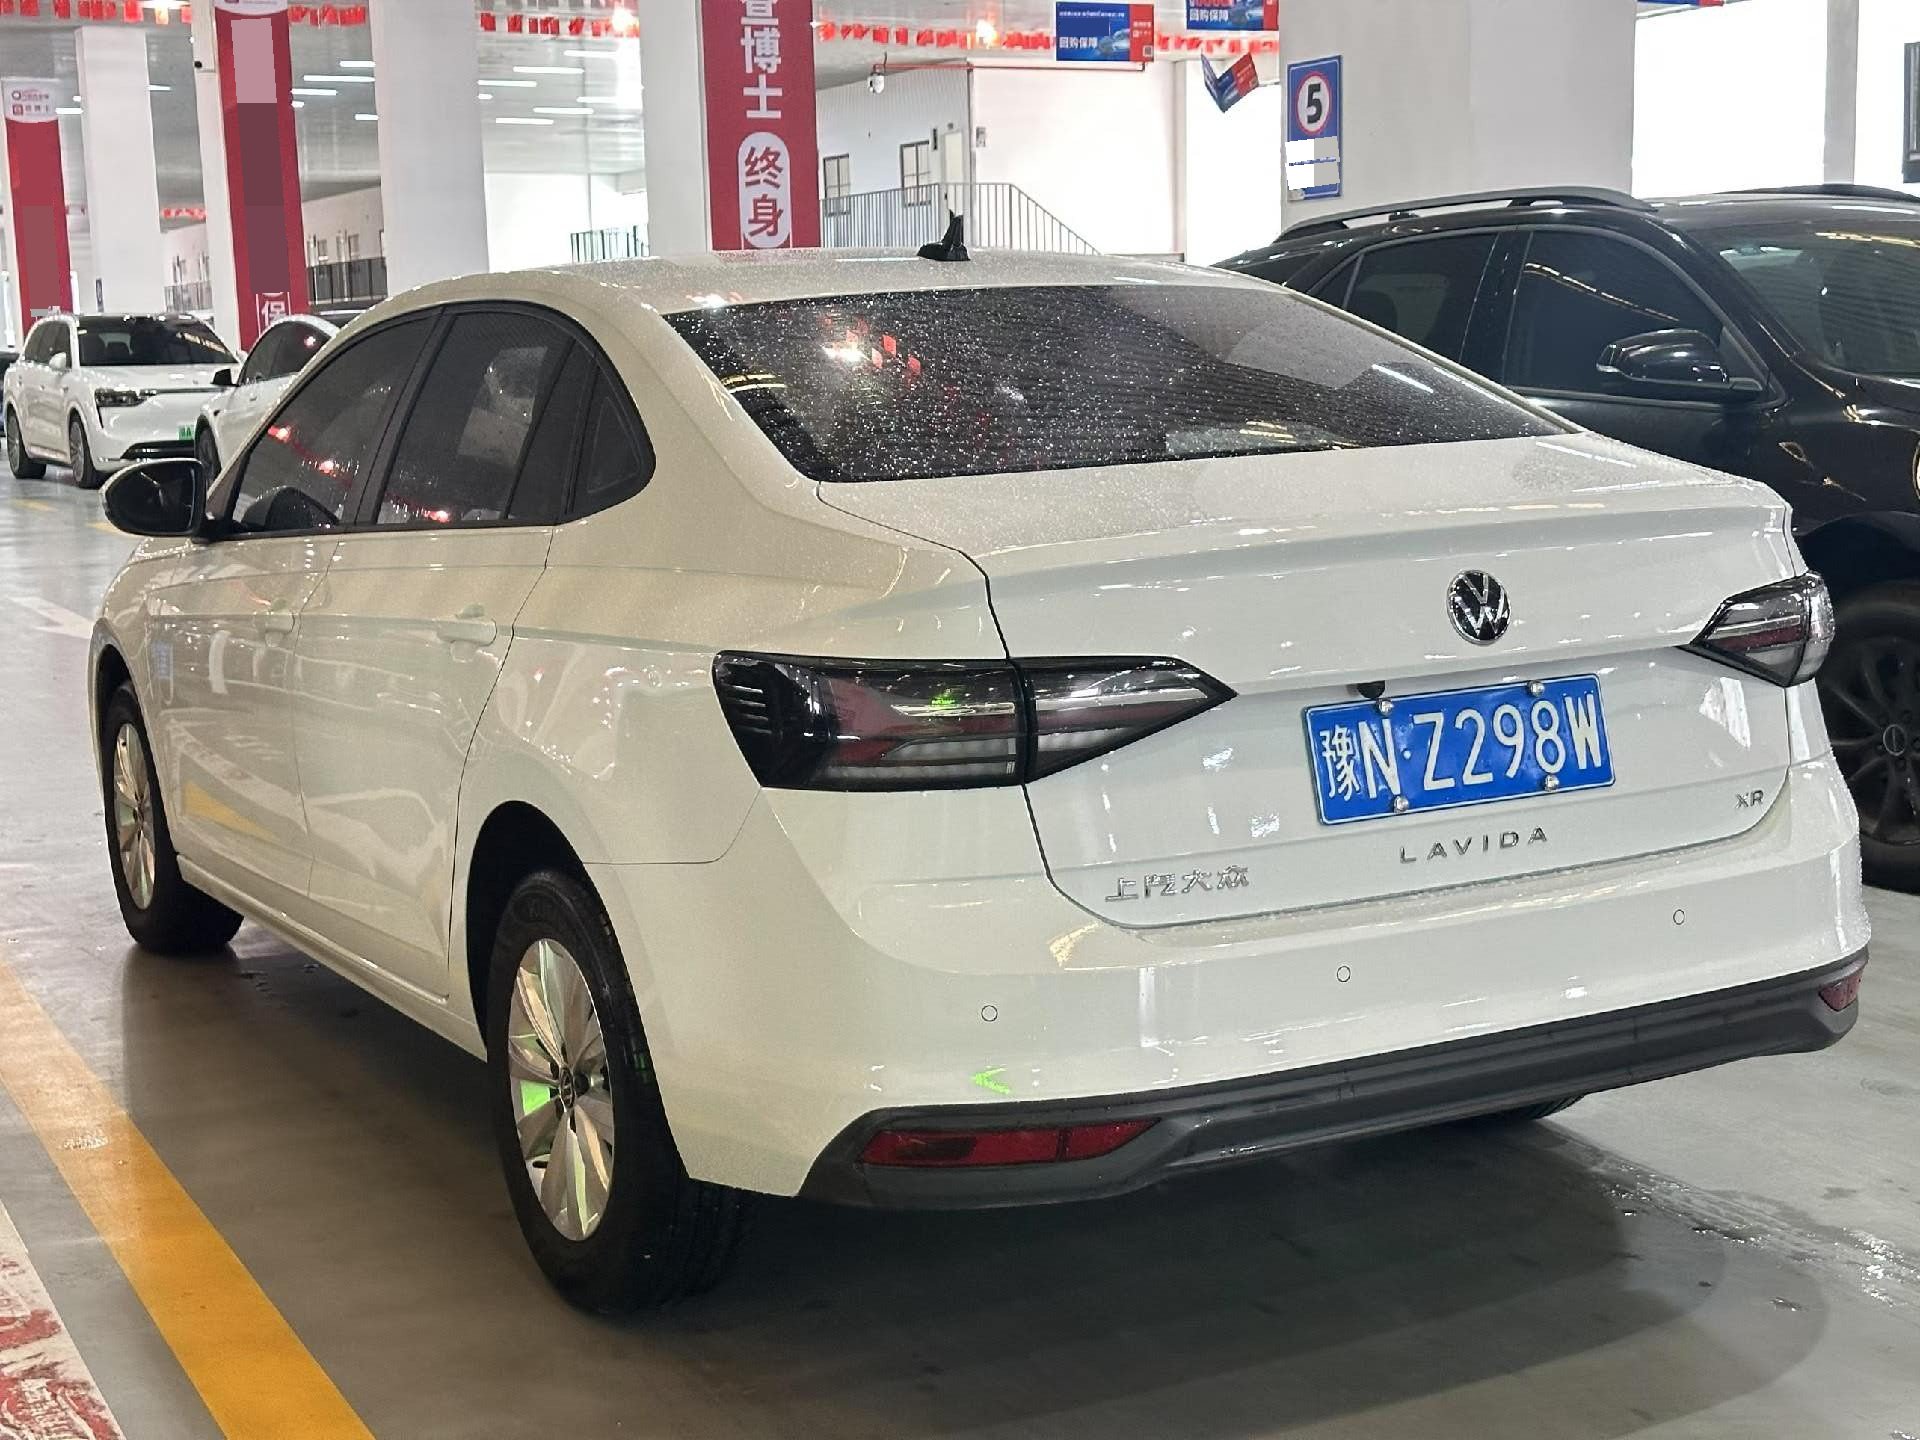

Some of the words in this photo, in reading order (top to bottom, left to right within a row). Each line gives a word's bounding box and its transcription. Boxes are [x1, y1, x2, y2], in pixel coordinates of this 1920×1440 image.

[1059, 36, 1098, 49] 回购保障
[1306, 83, 1323, 124] 5
[744, 147, 784, 238] 终身
[1734, 790, 1764, 809] XR
[1399, 825, 1548, 864] LAVIDA
[1104, 865, 1250, 903] 上汽大众
